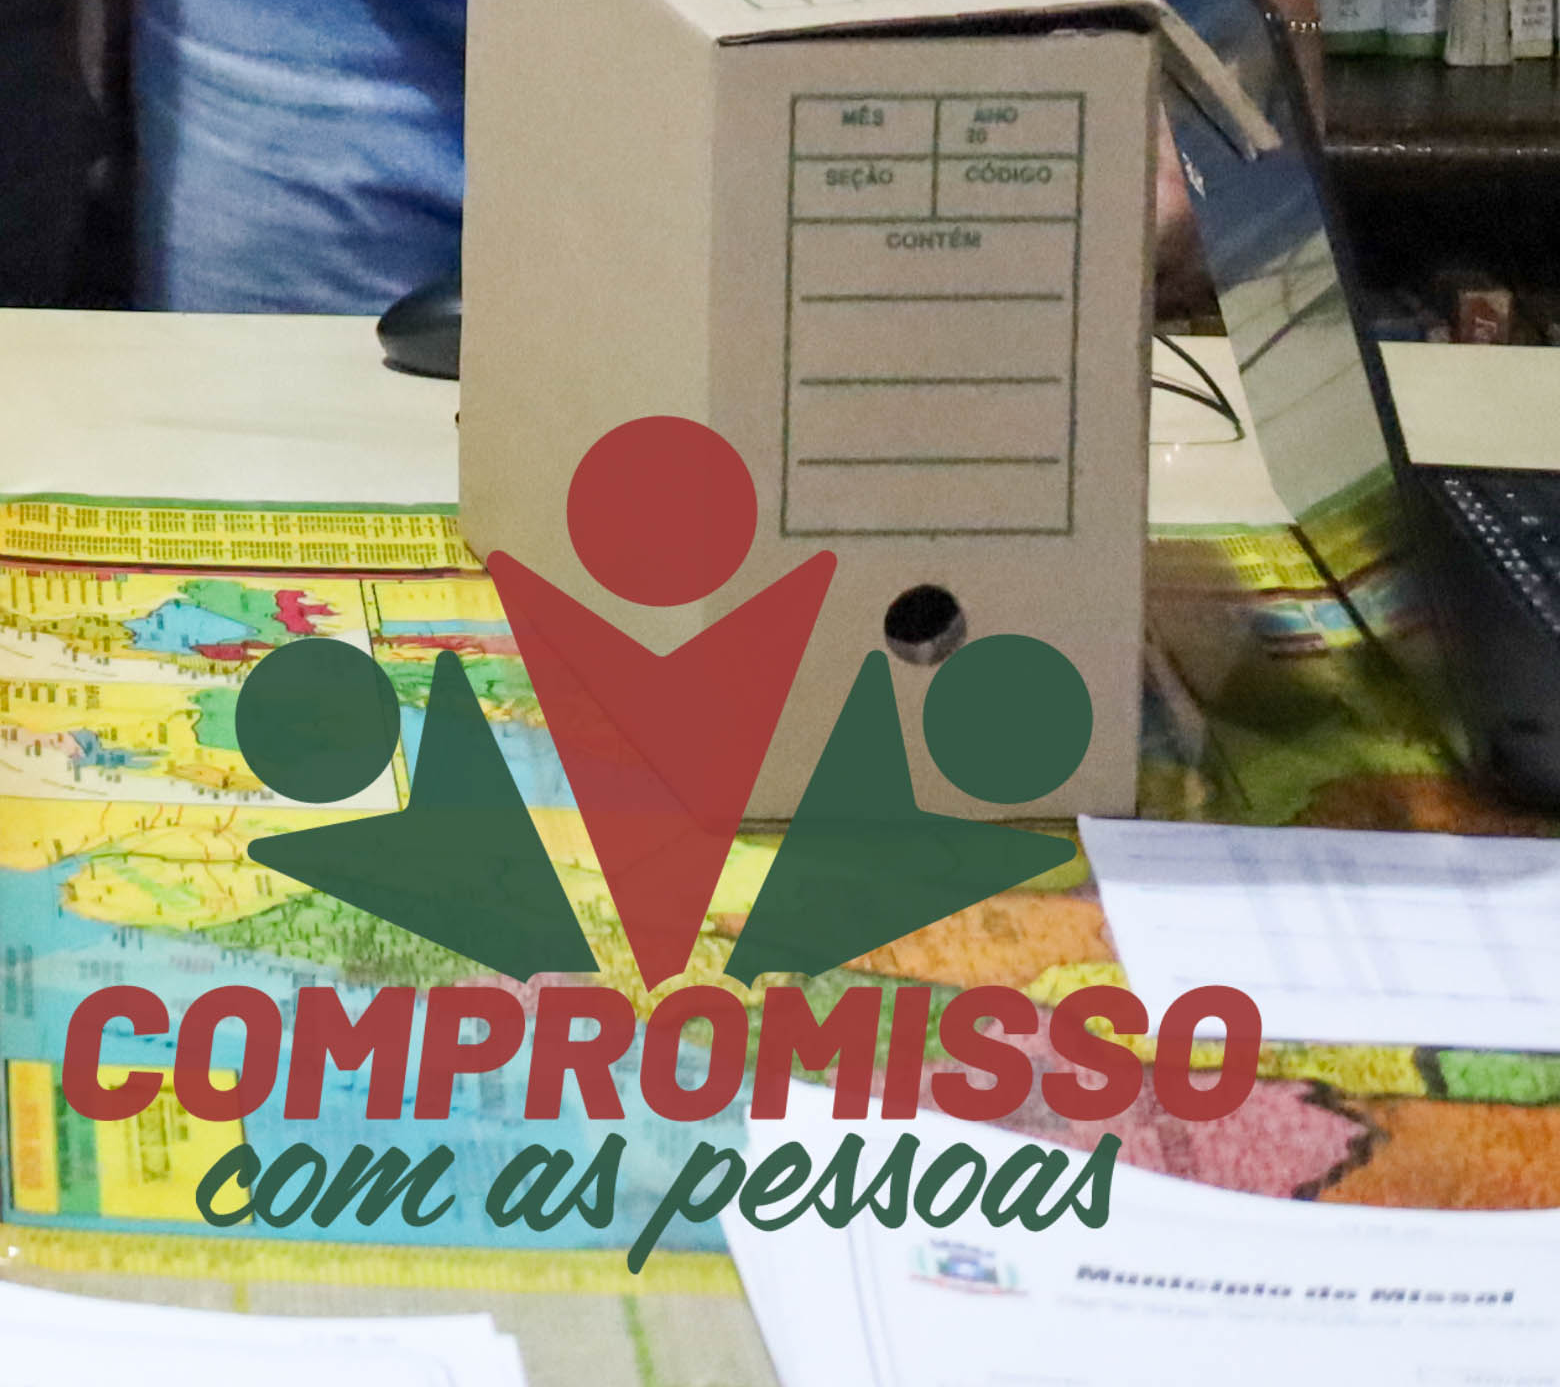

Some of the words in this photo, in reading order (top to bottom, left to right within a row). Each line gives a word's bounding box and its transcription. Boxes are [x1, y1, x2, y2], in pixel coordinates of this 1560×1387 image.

[842, 106, 884, 126] MÊS
[974, 107, 1018, 125] ANO
[826, 165, 893, 189] SEÇÃO
[966, 163, 1052, 184] CÓDIGO
[887, 227, 981, 248] CONTÉM
